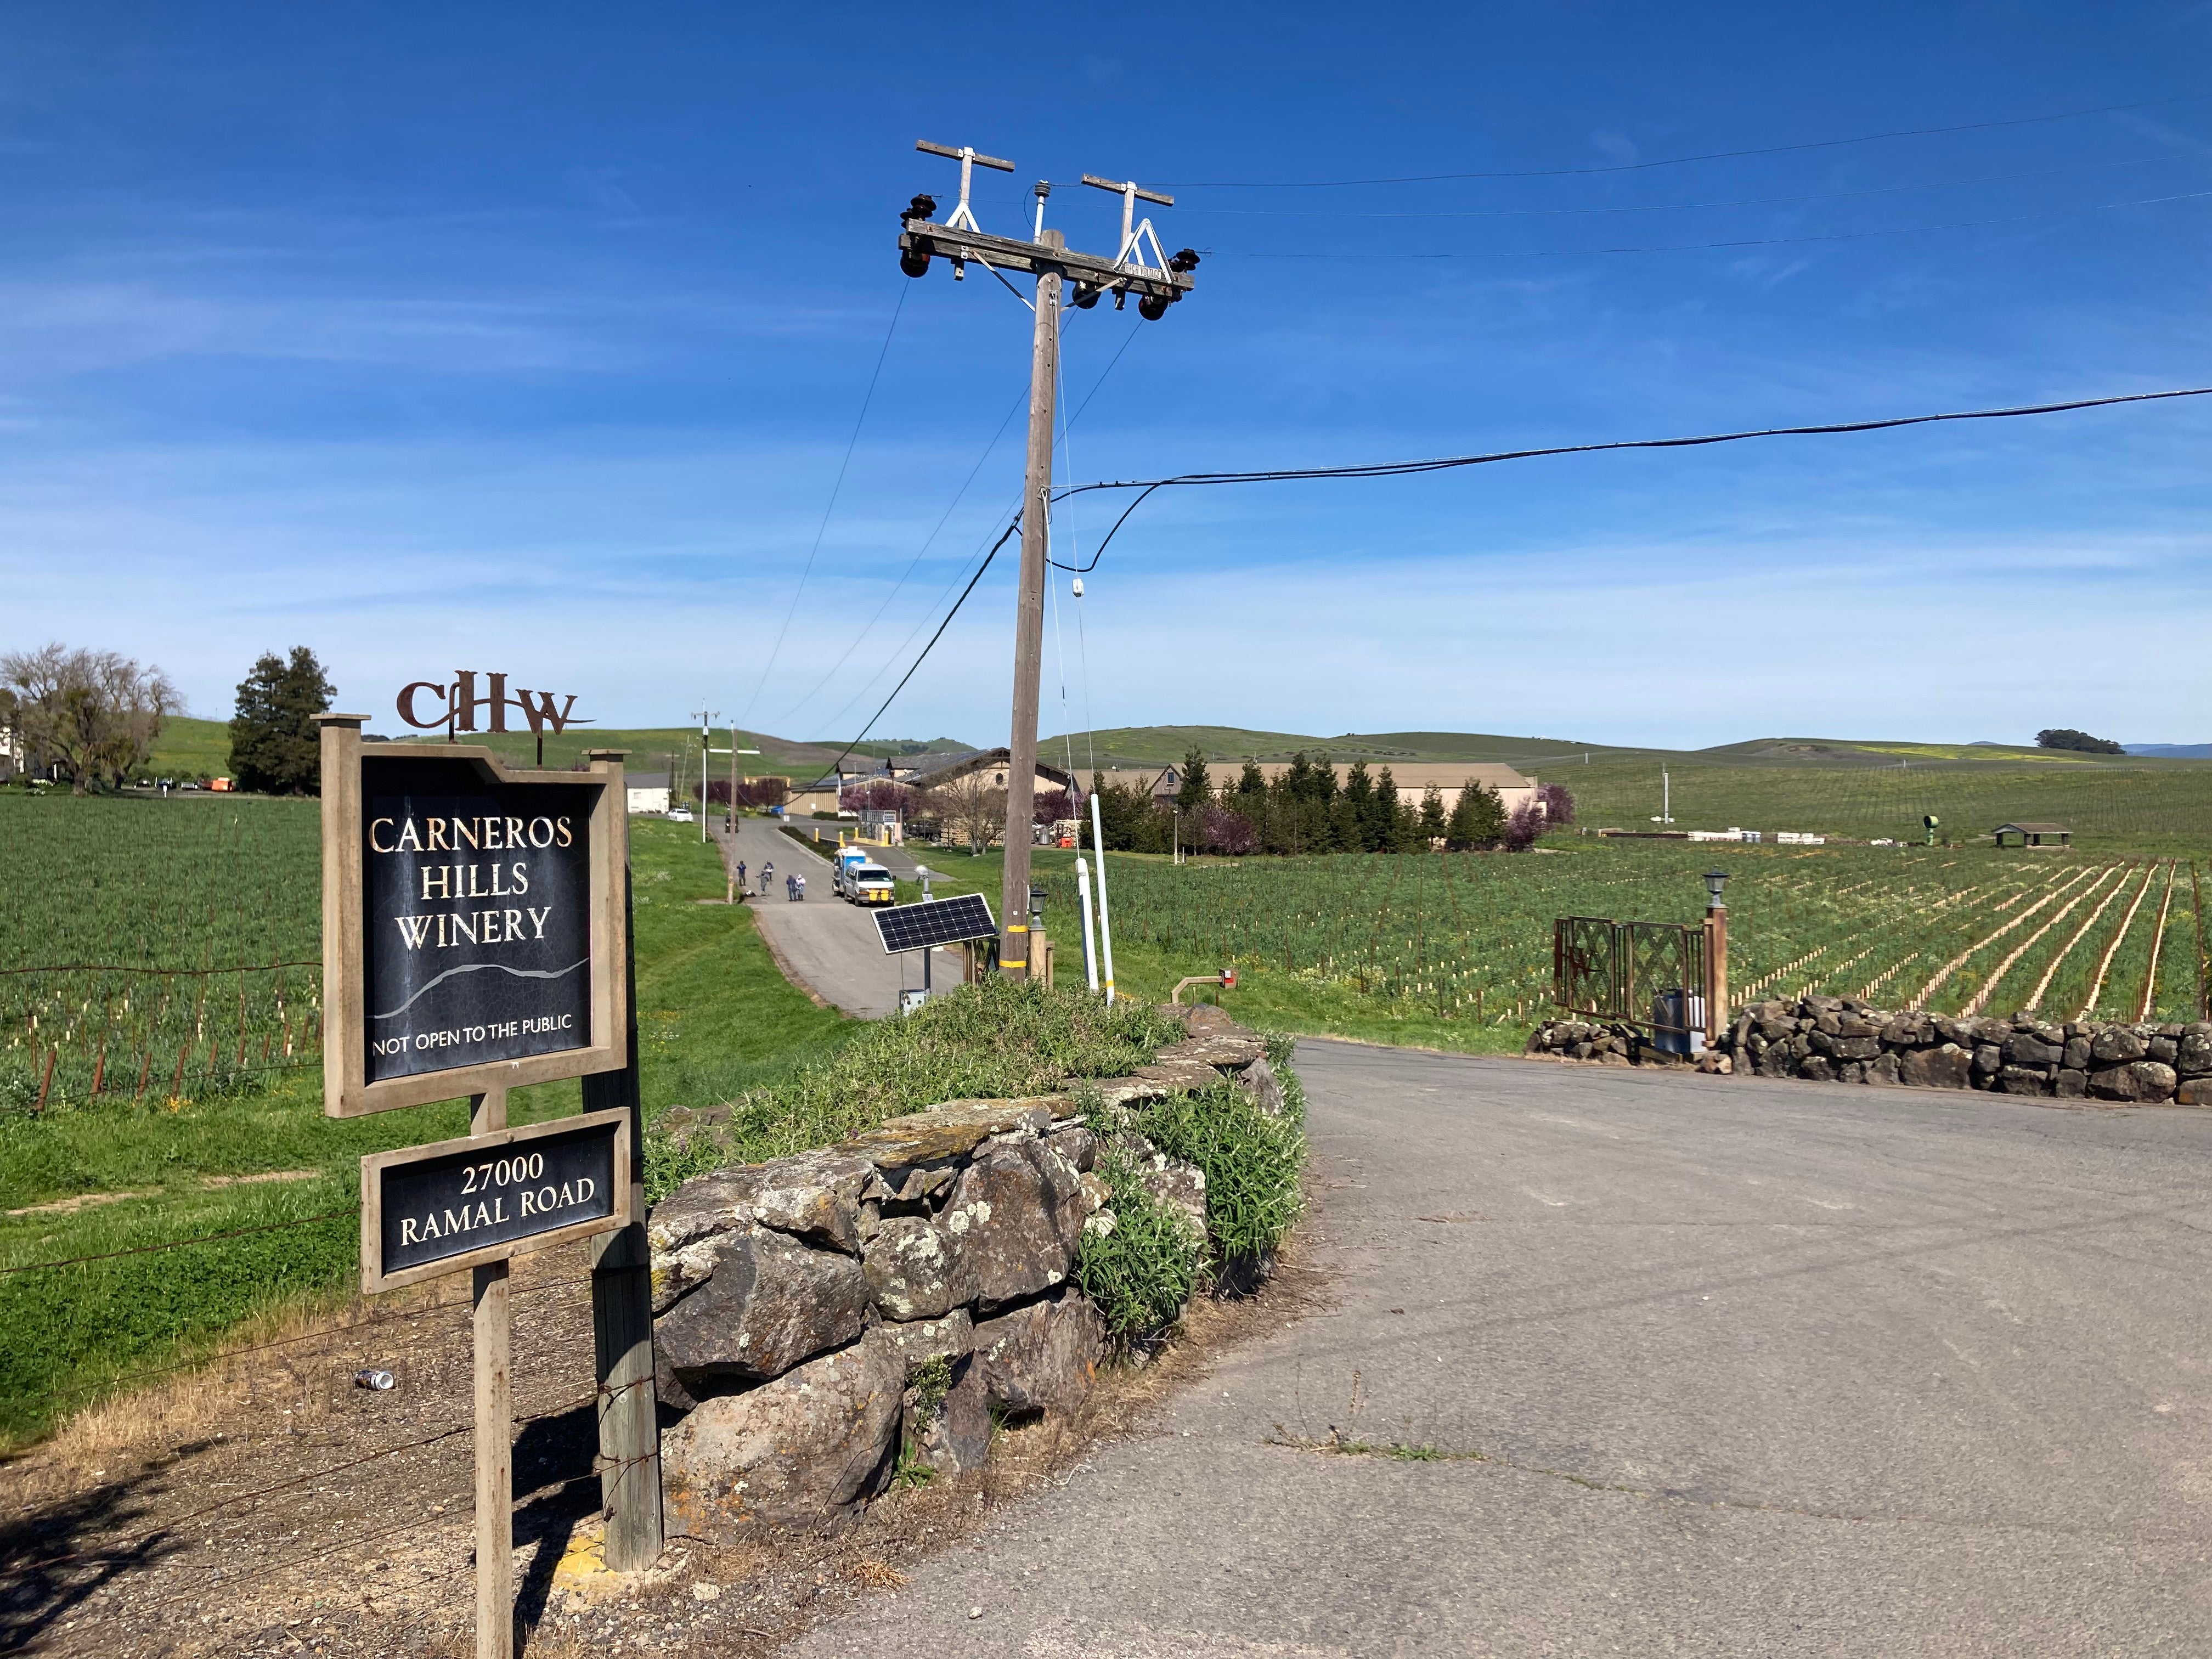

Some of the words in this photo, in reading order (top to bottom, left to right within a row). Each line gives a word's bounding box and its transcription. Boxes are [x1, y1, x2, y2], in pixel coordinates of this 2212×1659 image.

[1125, 263, 1139, 275] HIGH
[1141, 266, 1161, 279] VOLTAGE
[368, 816, 573, 853] CARNEROS
[420, 862, 528, 900] HILLS
[394, 906, 552, 950] WINERY
[373, 1036, 410, 1056] NOT
[415, 1029, 460, 1050] OPEN
[462, 1026, 486, 1043] TO
[488, 1022, 518, 1039] THE
[522, 1014, 572, 1035] PUBLIC
[460, 1153, 543, 1195] 27000
[400, 1197, 510, 1246] RAMAL
[520, 1177, 595, 1217] ROAD
